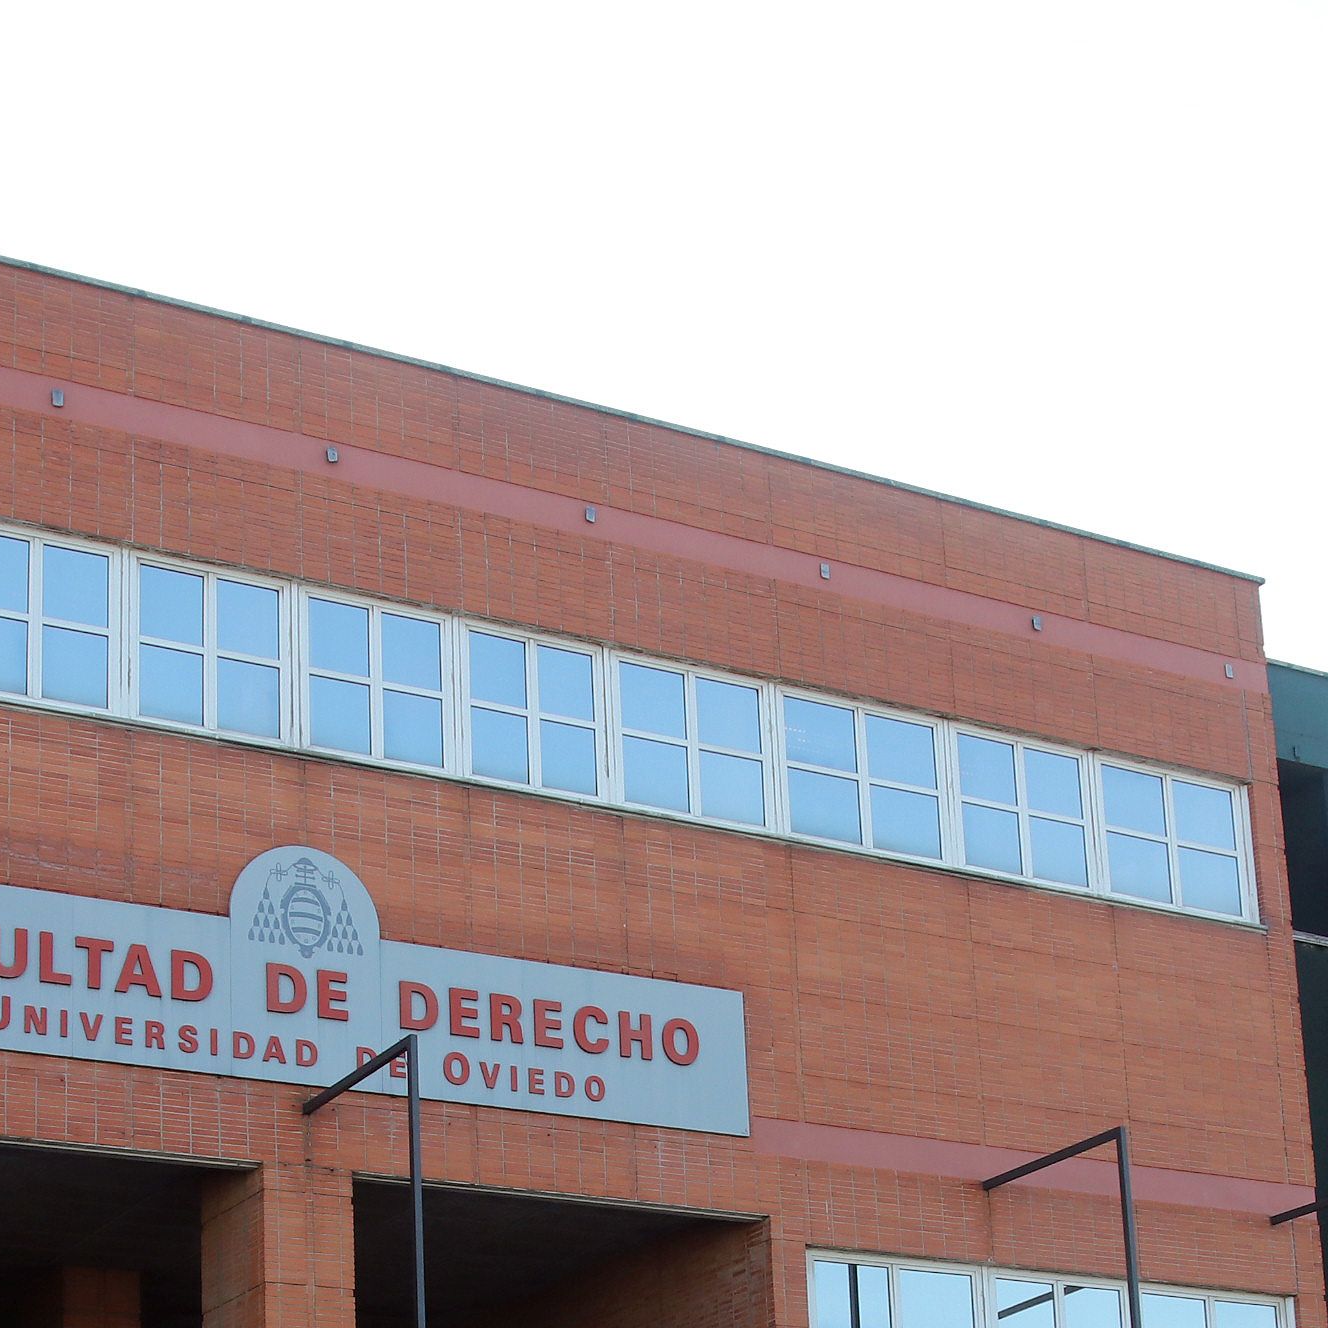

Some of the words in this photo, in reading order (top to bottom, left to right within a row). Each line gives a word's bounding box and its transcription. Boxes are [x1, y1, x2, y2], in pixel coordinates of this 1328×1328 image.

[265, 961, 349, 1022] DE
[398, 980, 700, 1066] DERECHO
[443, 1051, 606, 1102] OVIEDO
